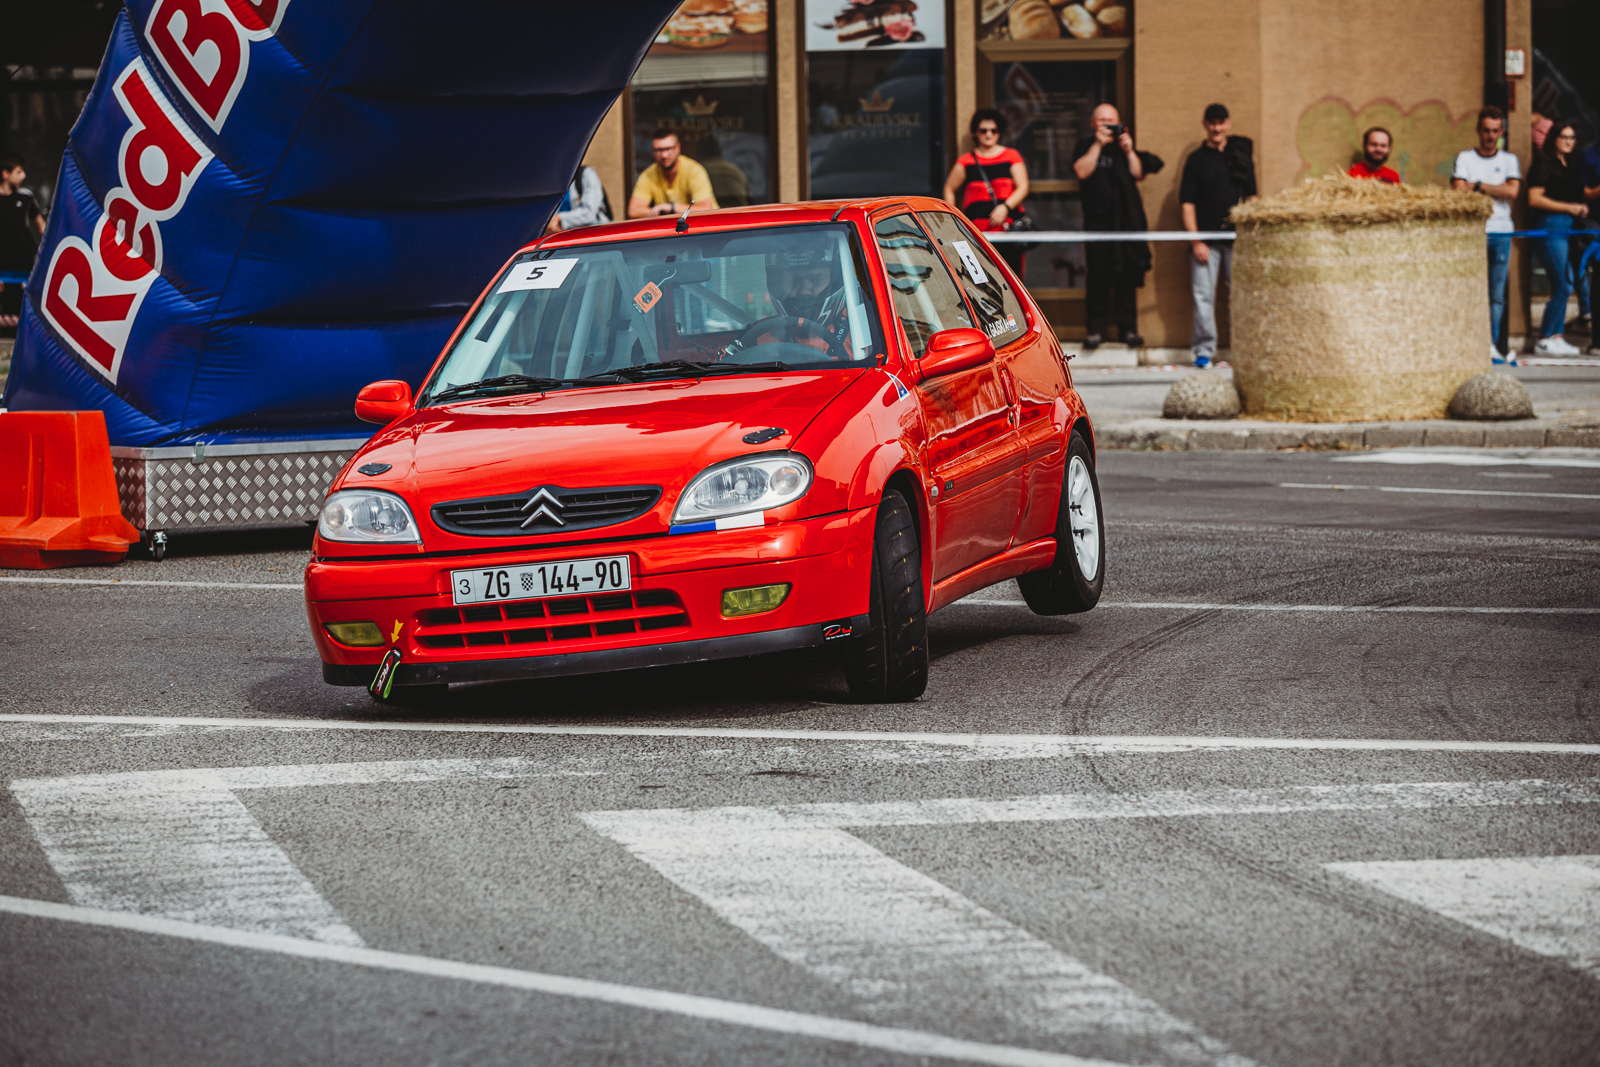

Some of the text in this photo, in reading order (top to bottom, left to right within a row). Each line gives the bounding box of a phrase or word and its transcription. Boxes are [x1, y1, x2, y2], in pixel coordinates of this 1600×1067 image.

[43, 59, 211, 381] Red
[525, 266, 548, 280] 5
[966, 255, 978, 275] 5
[459, 560, 622, 599] 3 ZG 144-90
